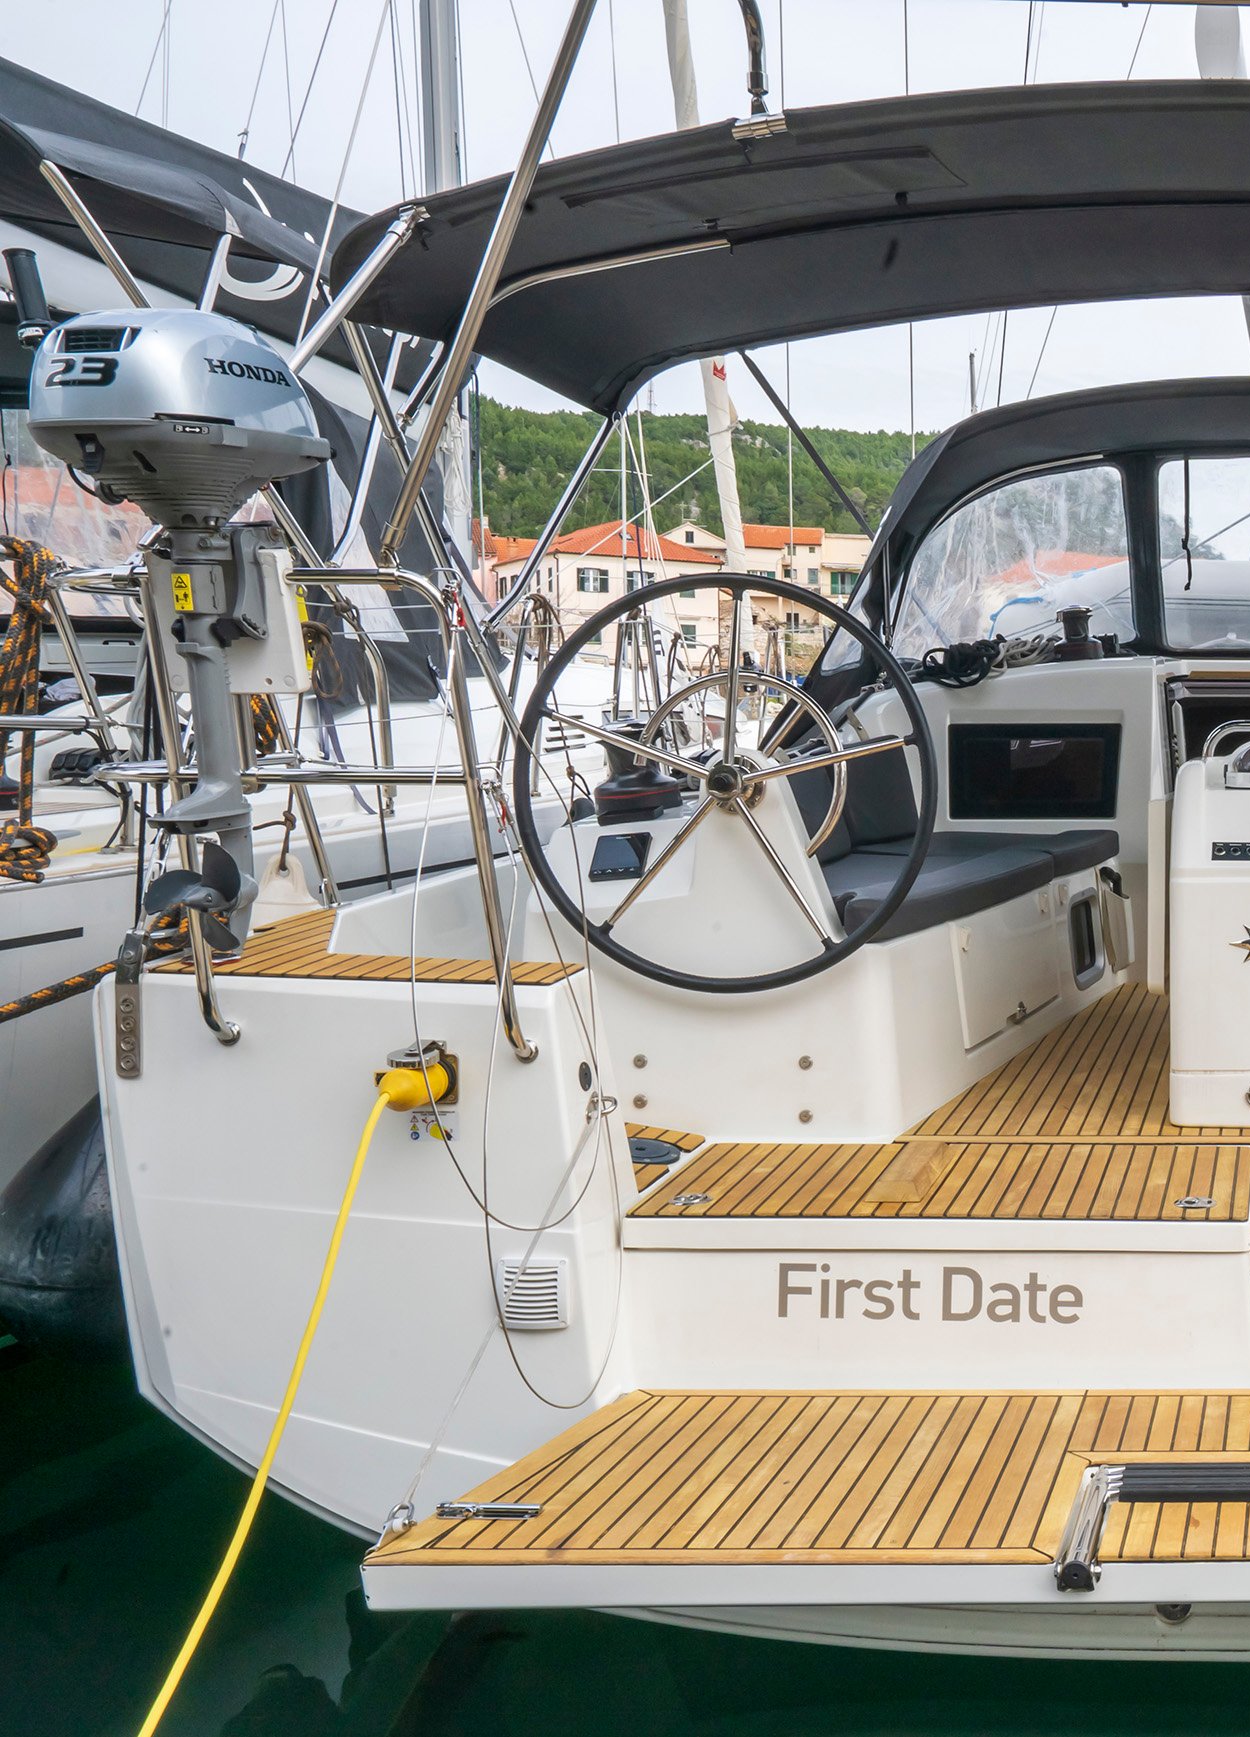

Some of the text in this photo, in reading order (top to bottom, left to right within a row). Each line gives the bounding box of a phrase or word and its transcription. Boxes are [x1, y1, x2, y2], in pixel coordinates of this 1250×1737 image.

[203, 357, 291, 387] HONDA
[778, 1263, 1084, 1324] First Date
